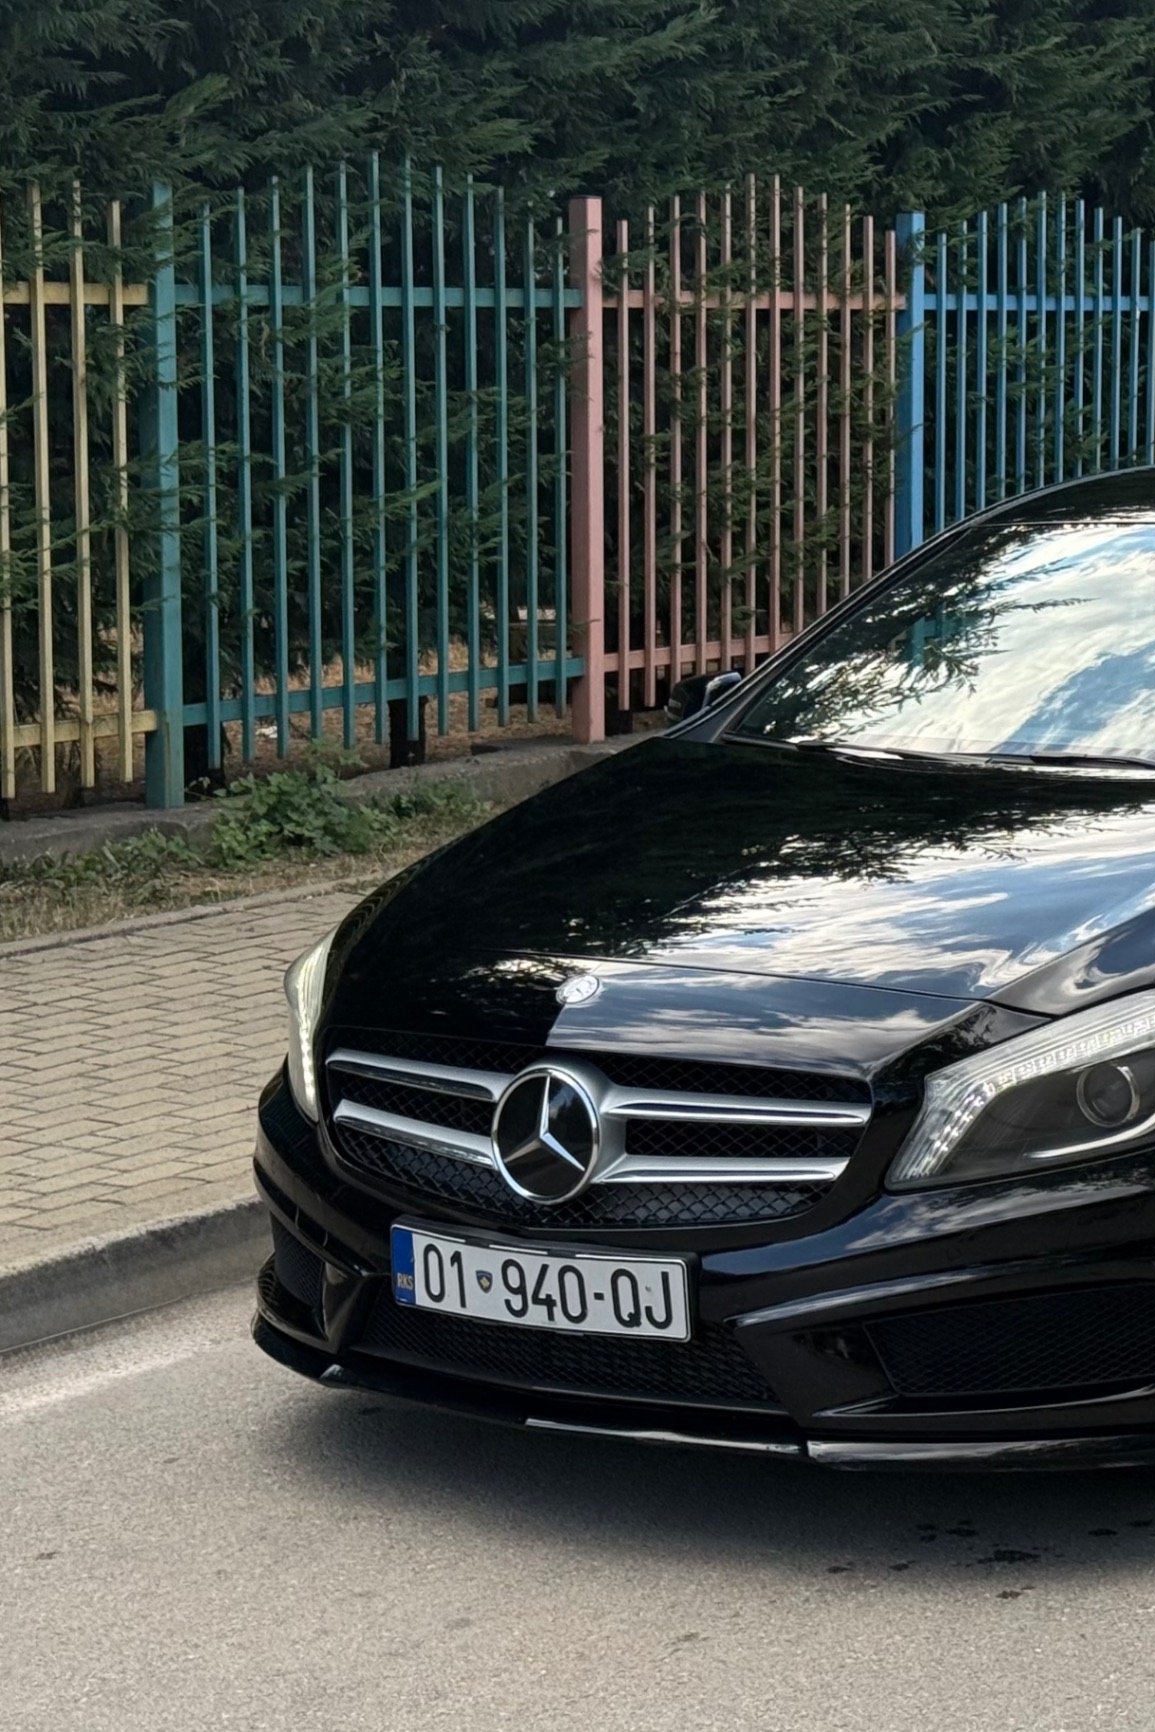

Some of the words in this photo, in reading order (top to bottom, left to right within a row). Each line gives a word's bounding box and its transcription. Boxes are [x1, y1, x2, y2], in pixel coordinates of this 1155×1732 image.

[396, 1272, 414, 1290] RKS
[423, 1243, 467, 1309] 01
[501, 1258, 673, 1330] 940-QJ
